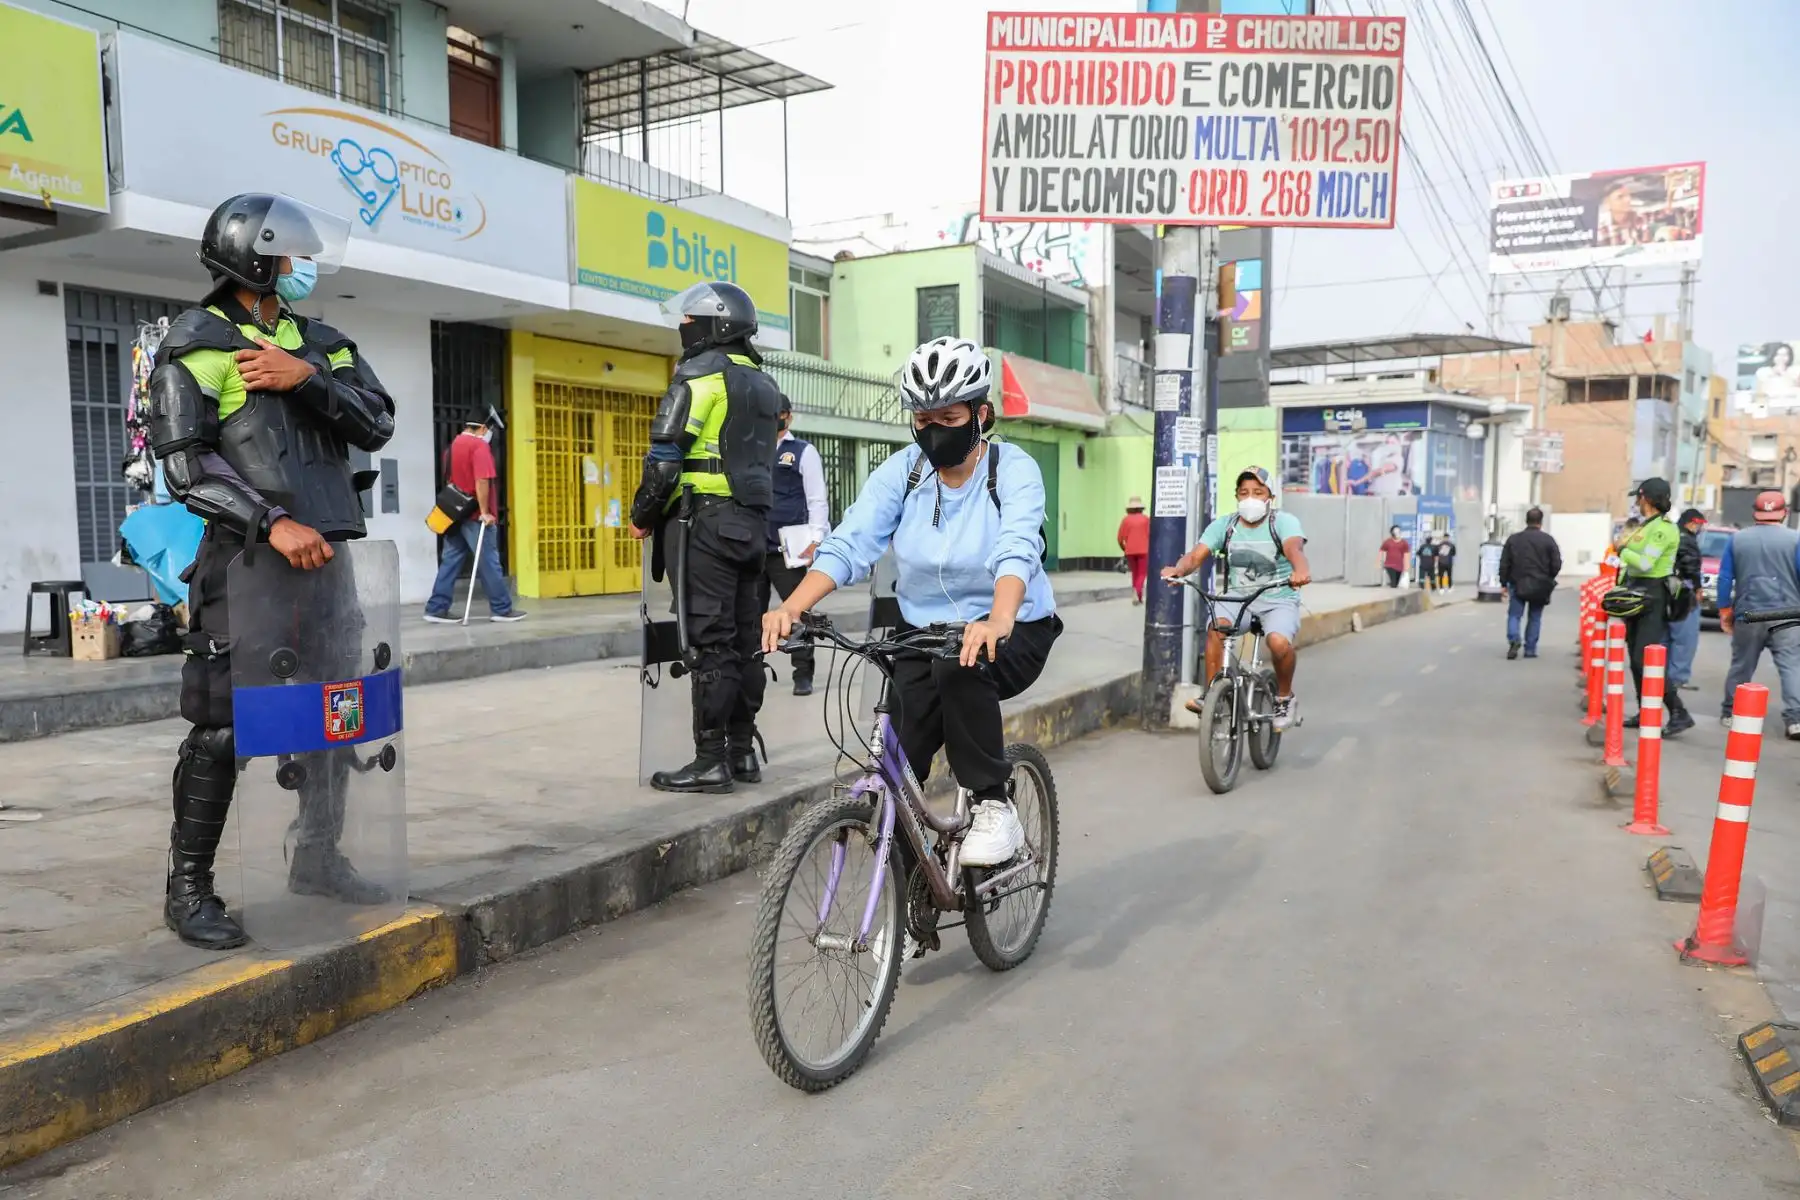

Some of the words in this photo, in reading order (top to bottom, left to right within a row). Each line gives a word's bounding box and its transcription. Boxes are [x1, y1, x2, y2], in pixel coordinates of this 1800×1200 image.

[991, 16, 1198, 48] MUNICIPALIDAD
[1206, 18, 1228, 48] DE
[1236, 19, 1401, 51] CHORRILLOS
[994, 59, 1177, 106] PROHIBIDO
[1182, 61, 1212, 107] EL
[1218, 61, 1394, 110] COMERCIO
[991, 113, 1189, 160] AMBULATORIO
[1194, 115, 1280, 161] MULTA
[9, 162, 84, 195] Agente
[992, 166, 1010, 212] Y
[1019, 167, 1177, 214] DECOMISO
[1188, 168, 1252, 216] ORD.
[1260, 170, 1312, 217] 268
[1316, 170, 1389, 218] MDCH
[672, 226, 736, 284] bitel
